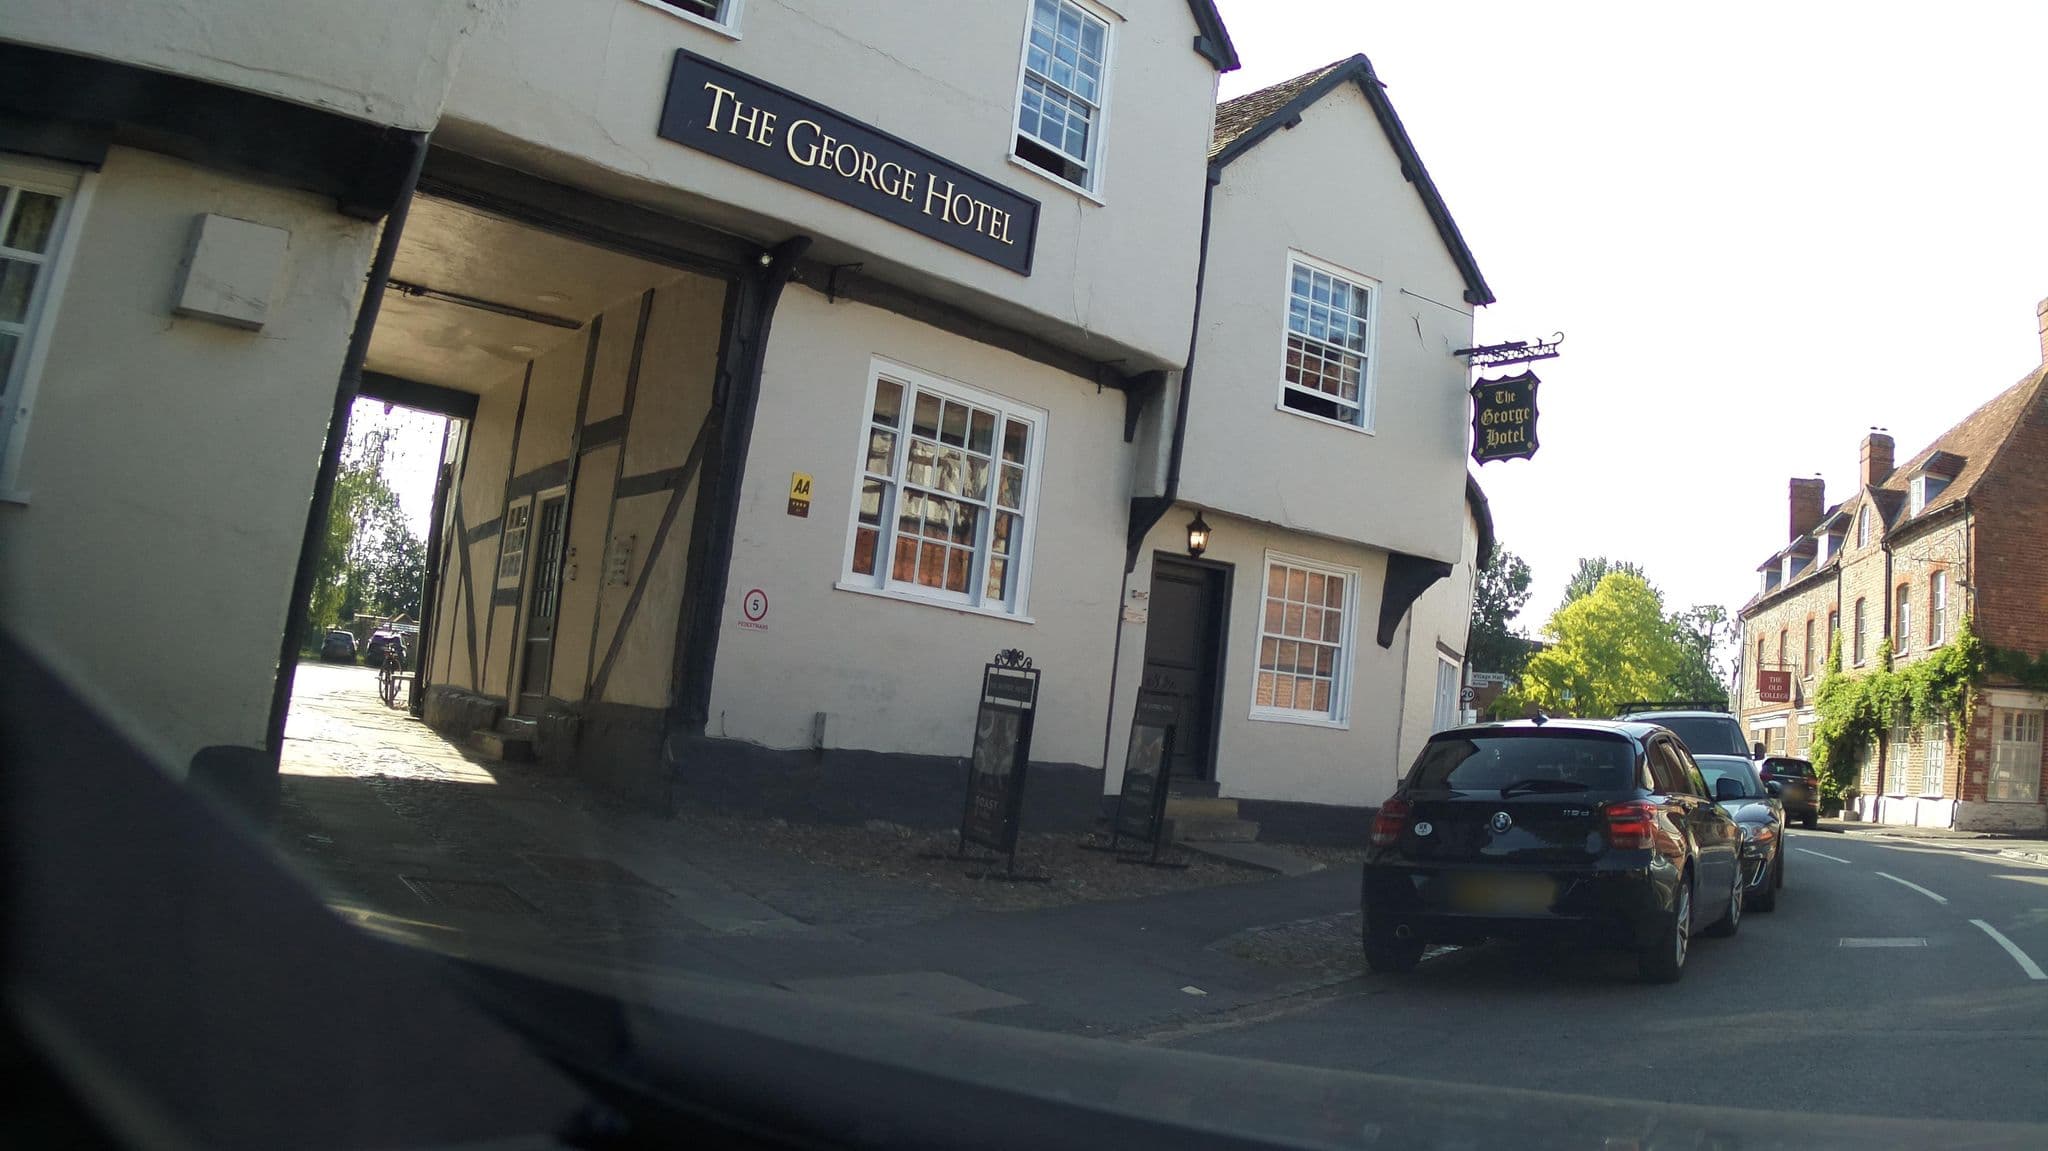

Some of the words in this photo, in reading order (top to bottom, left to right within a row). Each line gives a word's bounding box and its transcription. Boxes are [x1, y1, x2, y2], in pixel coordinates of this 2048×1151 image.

[703, 81, 777, 148] THE
[785, 118, 918, 204] GEORGE
[921, 172, 1015, 246] HOTEL
[1495, 391, 1516, 404] The
[1481, 407, 1530, 425] George
[1486, 426, 1525, 448] Hotel
[794, 479, 810, 495] AA
[753, 599, 759, 611] 5
